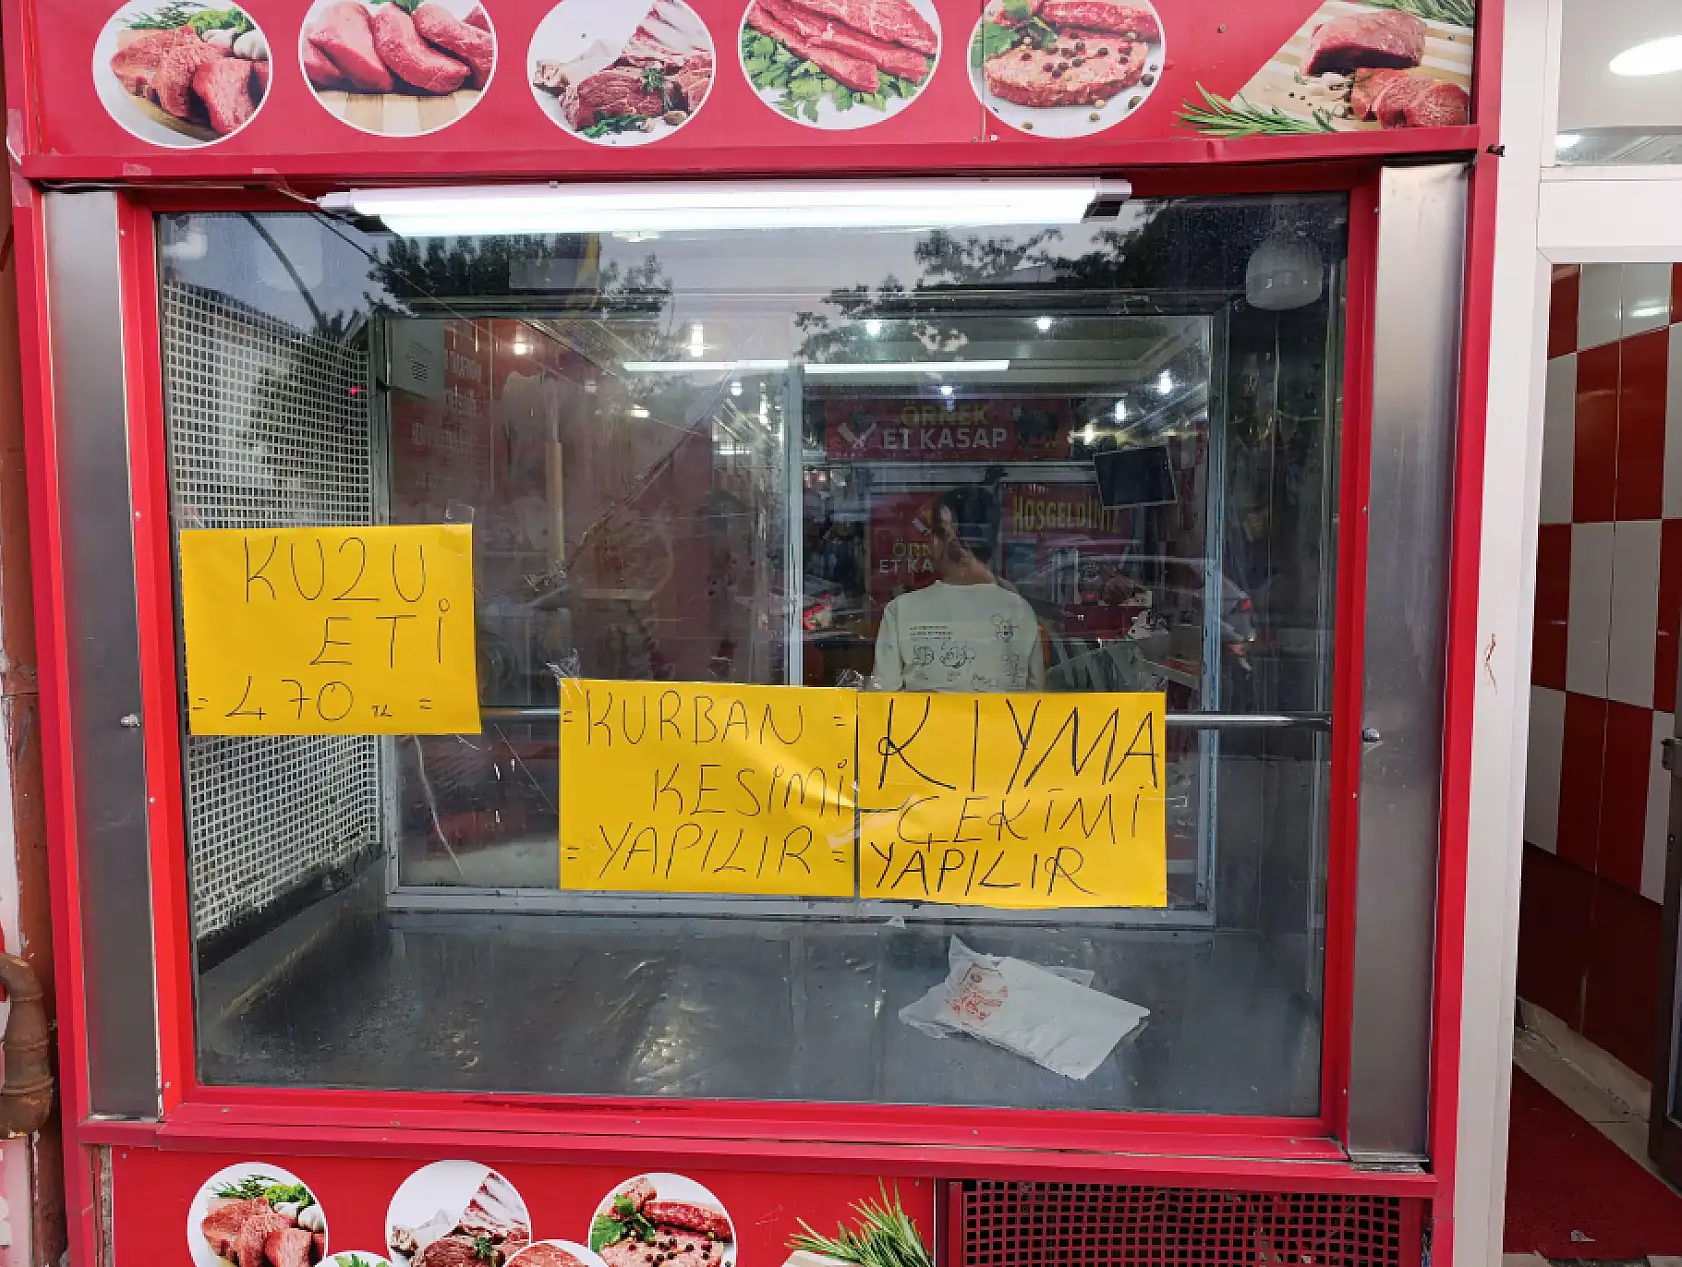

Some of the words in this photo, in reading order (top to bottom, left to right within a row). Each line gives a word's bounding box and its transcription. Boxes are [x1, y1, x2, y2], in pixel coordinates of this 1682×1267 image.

[882, 428, 915, 449] ET
[919, 427, 1007, 449] KASAP
[879, 559, 902, 574] ET
[308, 597, 451, 669] ETİ
[225, 676, 355, 722] 470
[585, 689, 804, 747] KURBAN
[877, 695, 1160, 794] KIYMA
[652, 758, 850, 819] KESİMİ
[895, 785, 1143, 853] ÇEKİMİ
[597, 821, 815, 880] YAPILIR
[869, 842, 1099, 897] YAPILIR
